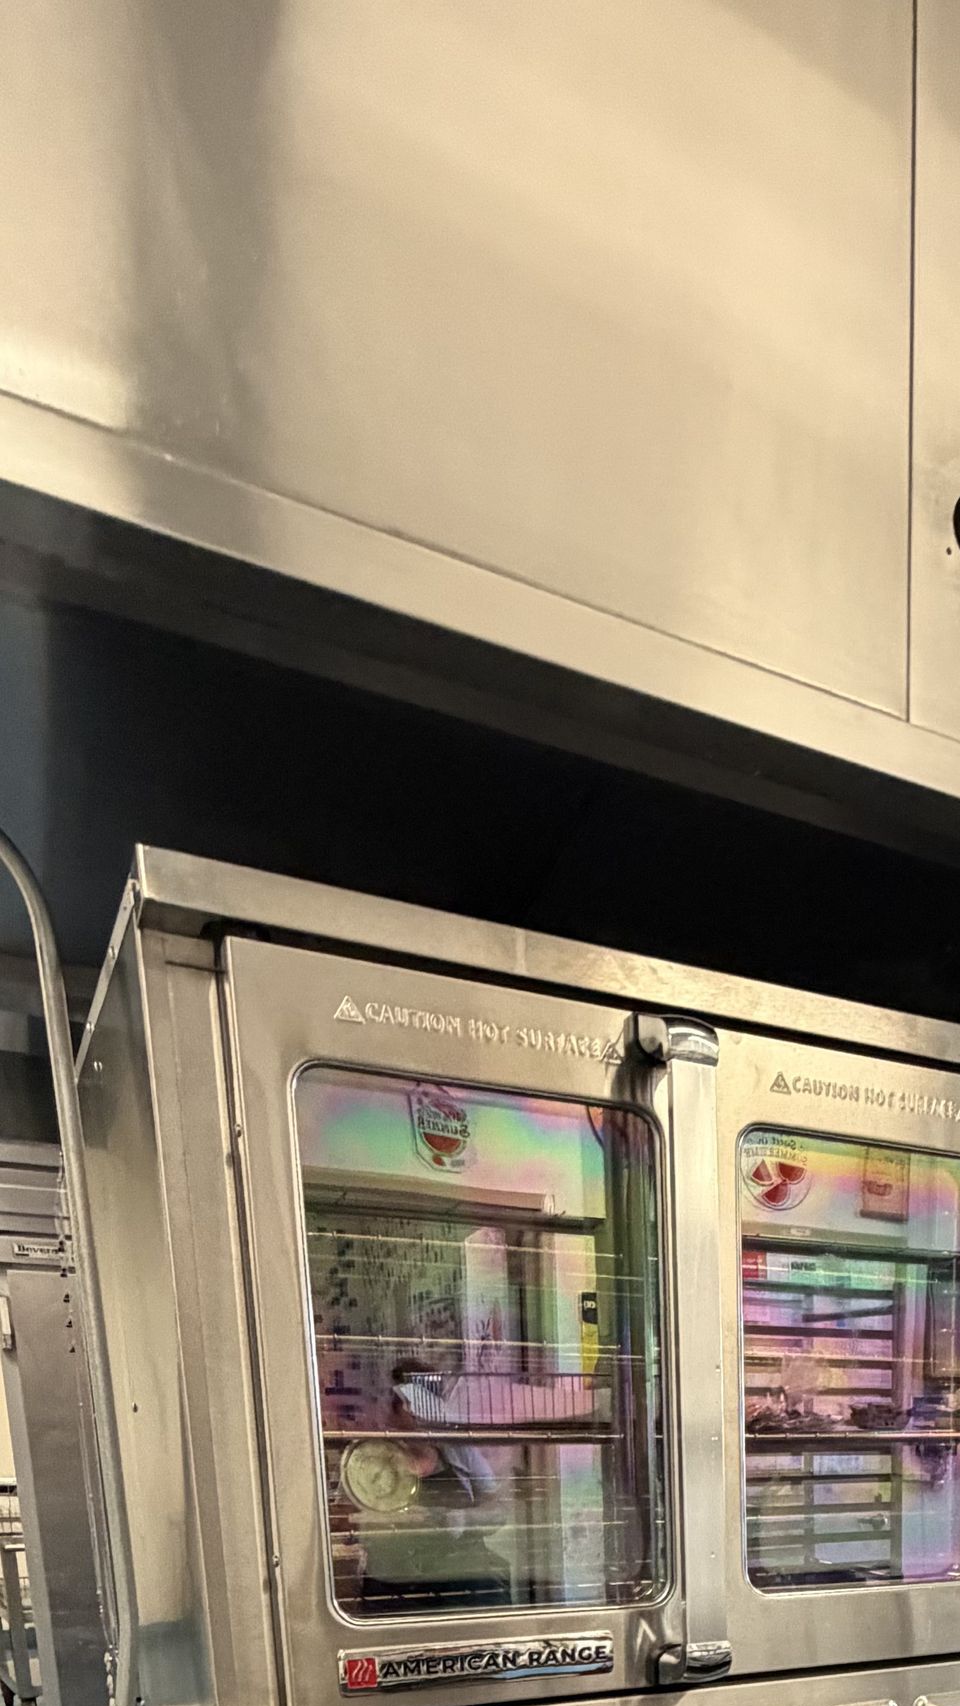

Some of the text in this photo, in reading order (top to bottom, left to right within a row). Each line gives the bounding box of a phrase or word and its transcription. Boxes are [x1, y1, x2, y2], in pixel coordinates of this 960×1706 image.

[364, 1001, 602, 1059] CAUTION HOT SURFACE
[791, 1075, 860, 1103] CAUTION
[864, 1087, 895, 1109] HOT
[381, 1644, 610, 1680] AMERICAN RANGE
